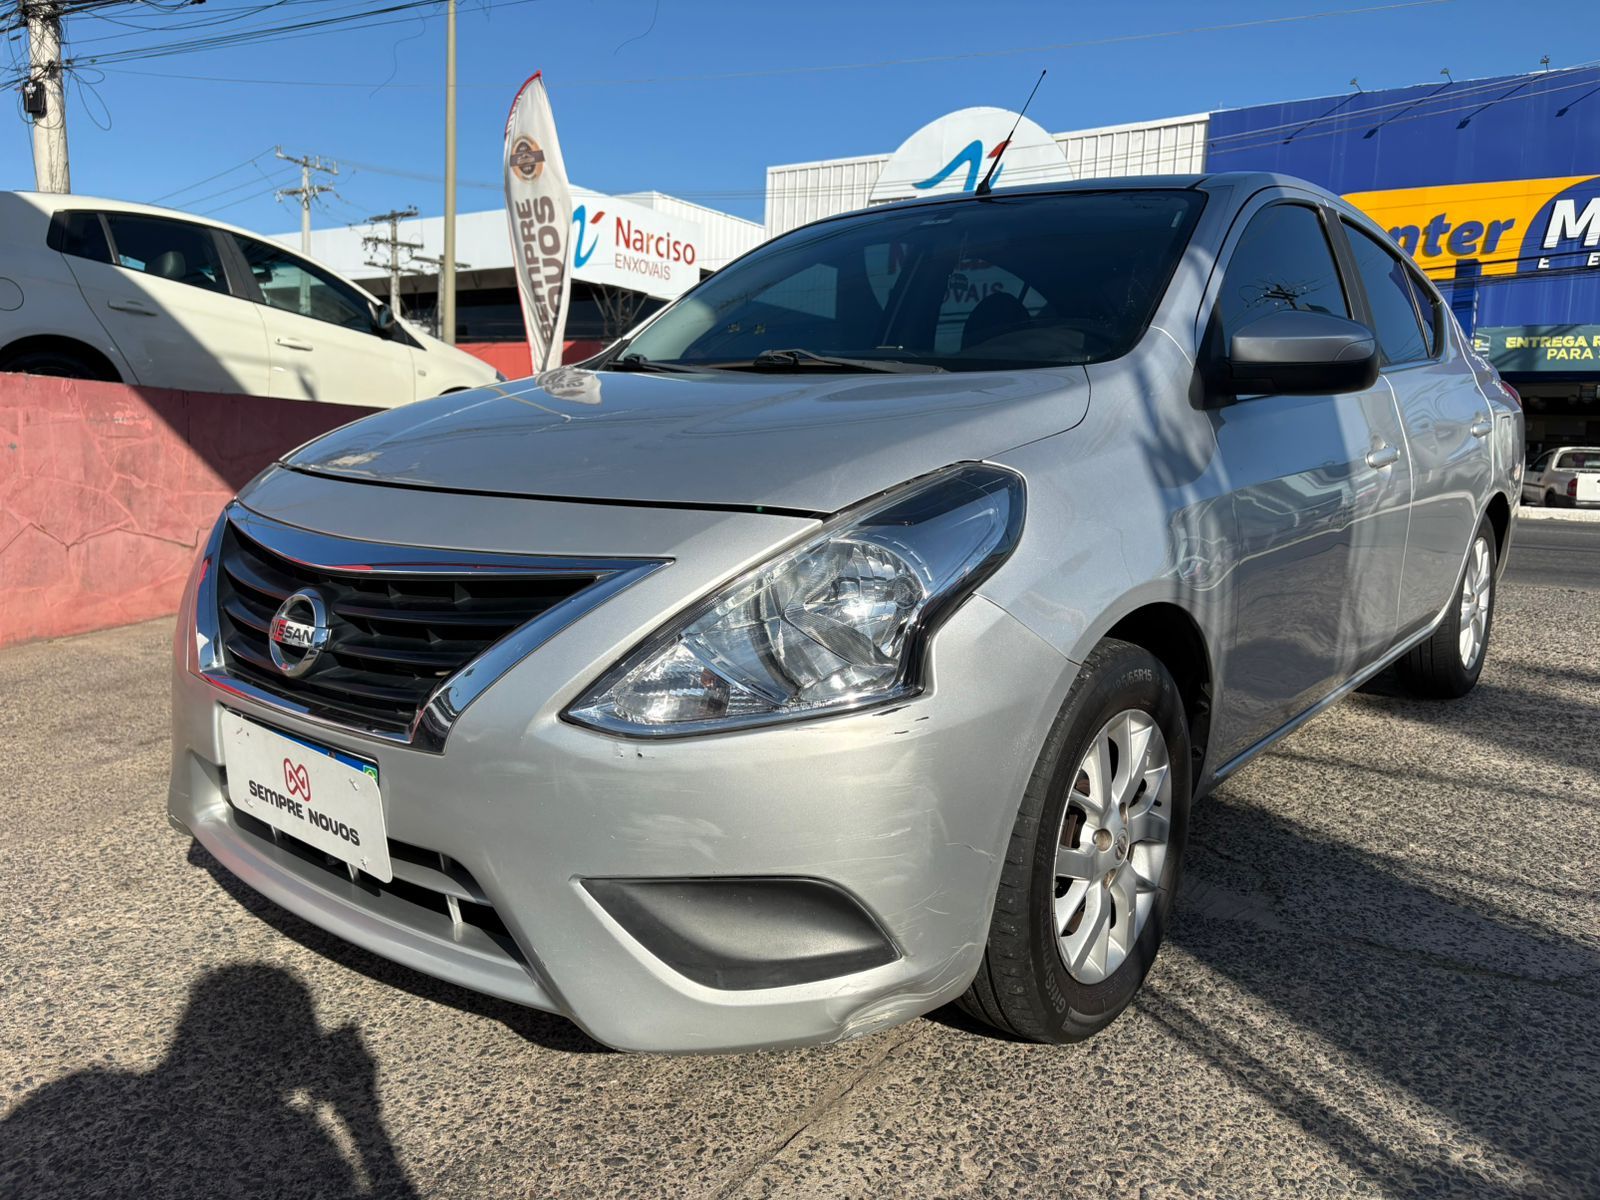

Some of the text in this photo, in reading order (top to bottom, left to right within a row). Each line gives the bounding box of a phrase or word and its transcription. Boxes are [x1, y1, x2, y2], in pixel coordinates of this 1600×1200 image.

[615, 216, 696, 266] Narciso
[1388, 212, 1516, 258] nter
[614, 252, 672, 281] ENXOVAIS
[1505, 335, 1588, 349] ENTREGA
[1547, 348, 1594, 360] PARA
[249, 780, 305, 820] SEMPRE
